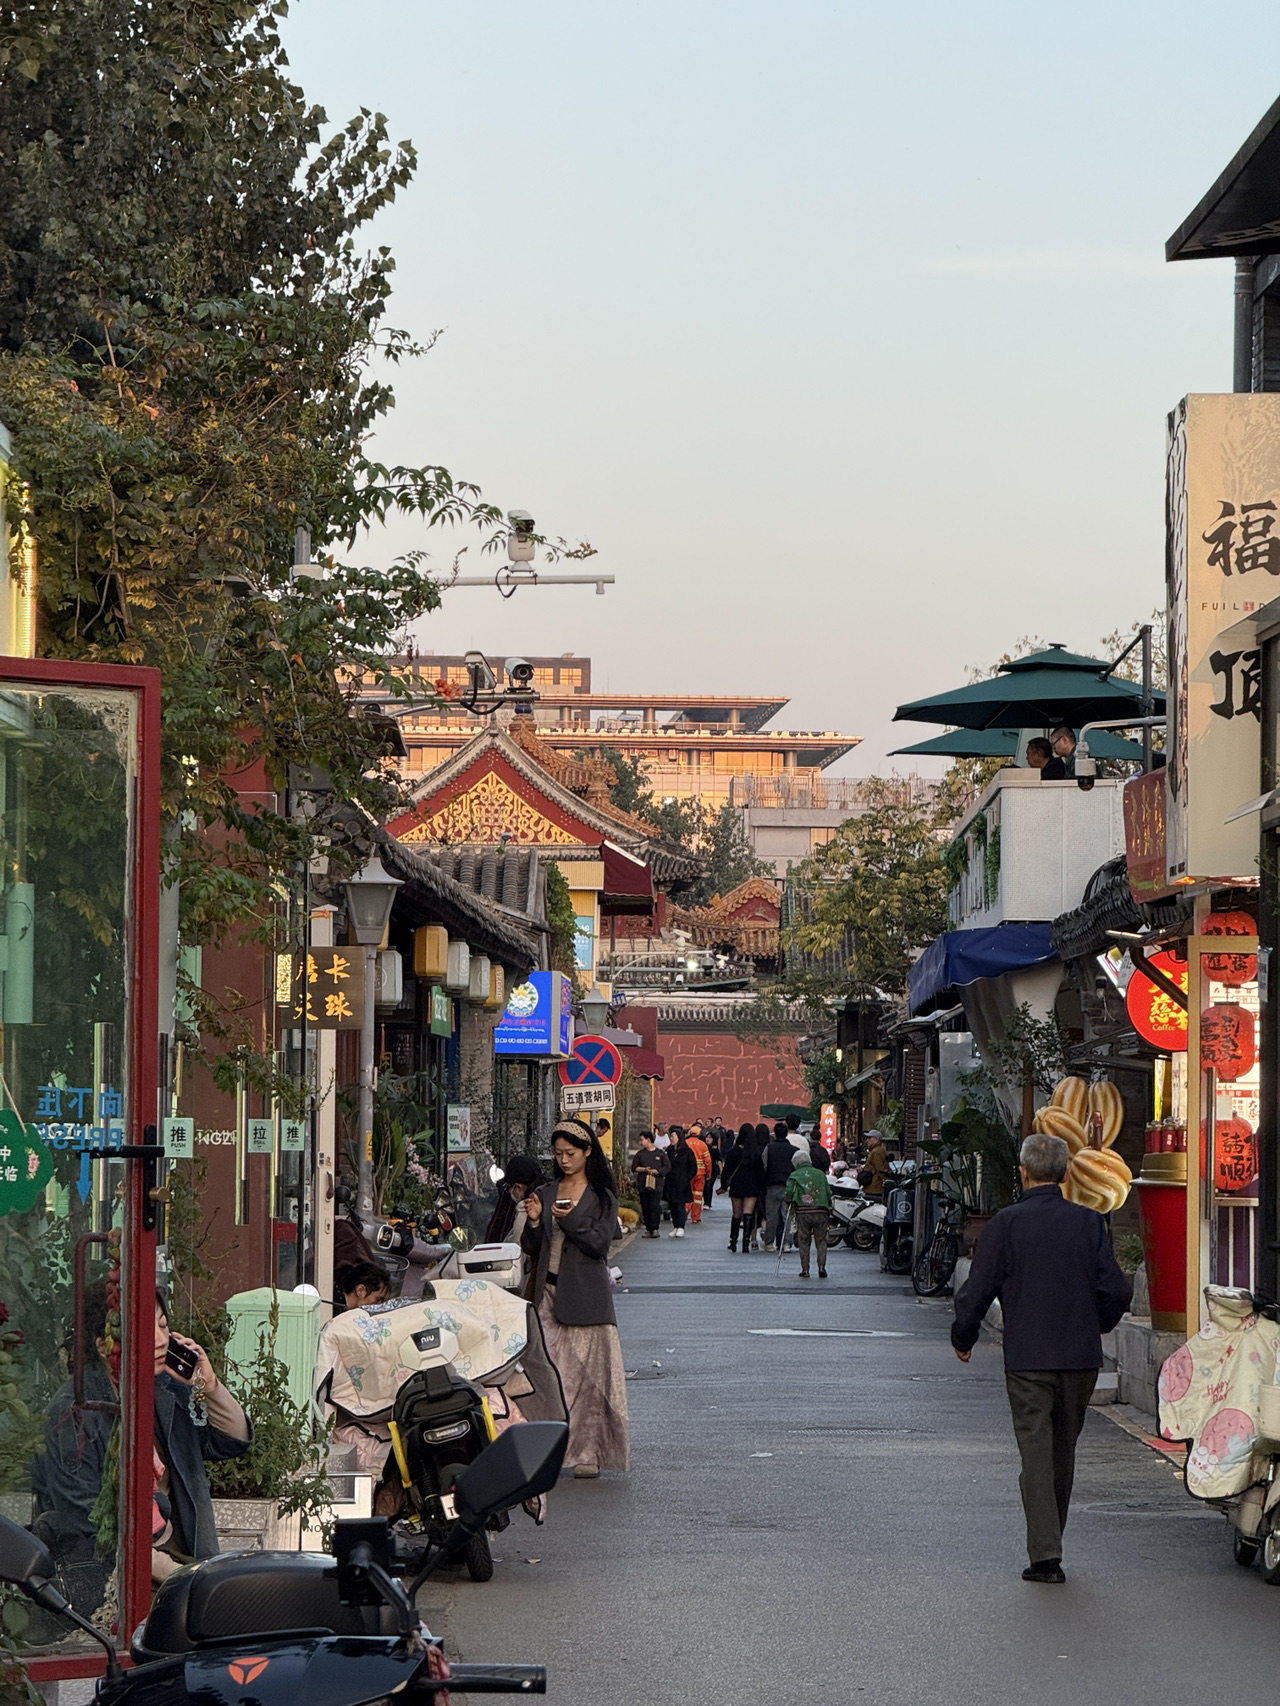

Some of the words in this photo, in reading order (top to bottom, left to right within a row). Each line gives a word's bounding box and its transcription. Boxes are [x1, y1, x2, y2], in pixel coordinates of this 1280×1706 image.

[1202, 500, 1280, 576] 福
[1152, 1023, 1176, 1031] Coffee
[566, 1090, 611, 1104] 五道营胡同
[170, 1126, 186, 1142] 推
[253, 1126, 267, 1139] 拉
[286, 1126, 299, 1139] 推
[0, 1165, 18, 1181] 临
